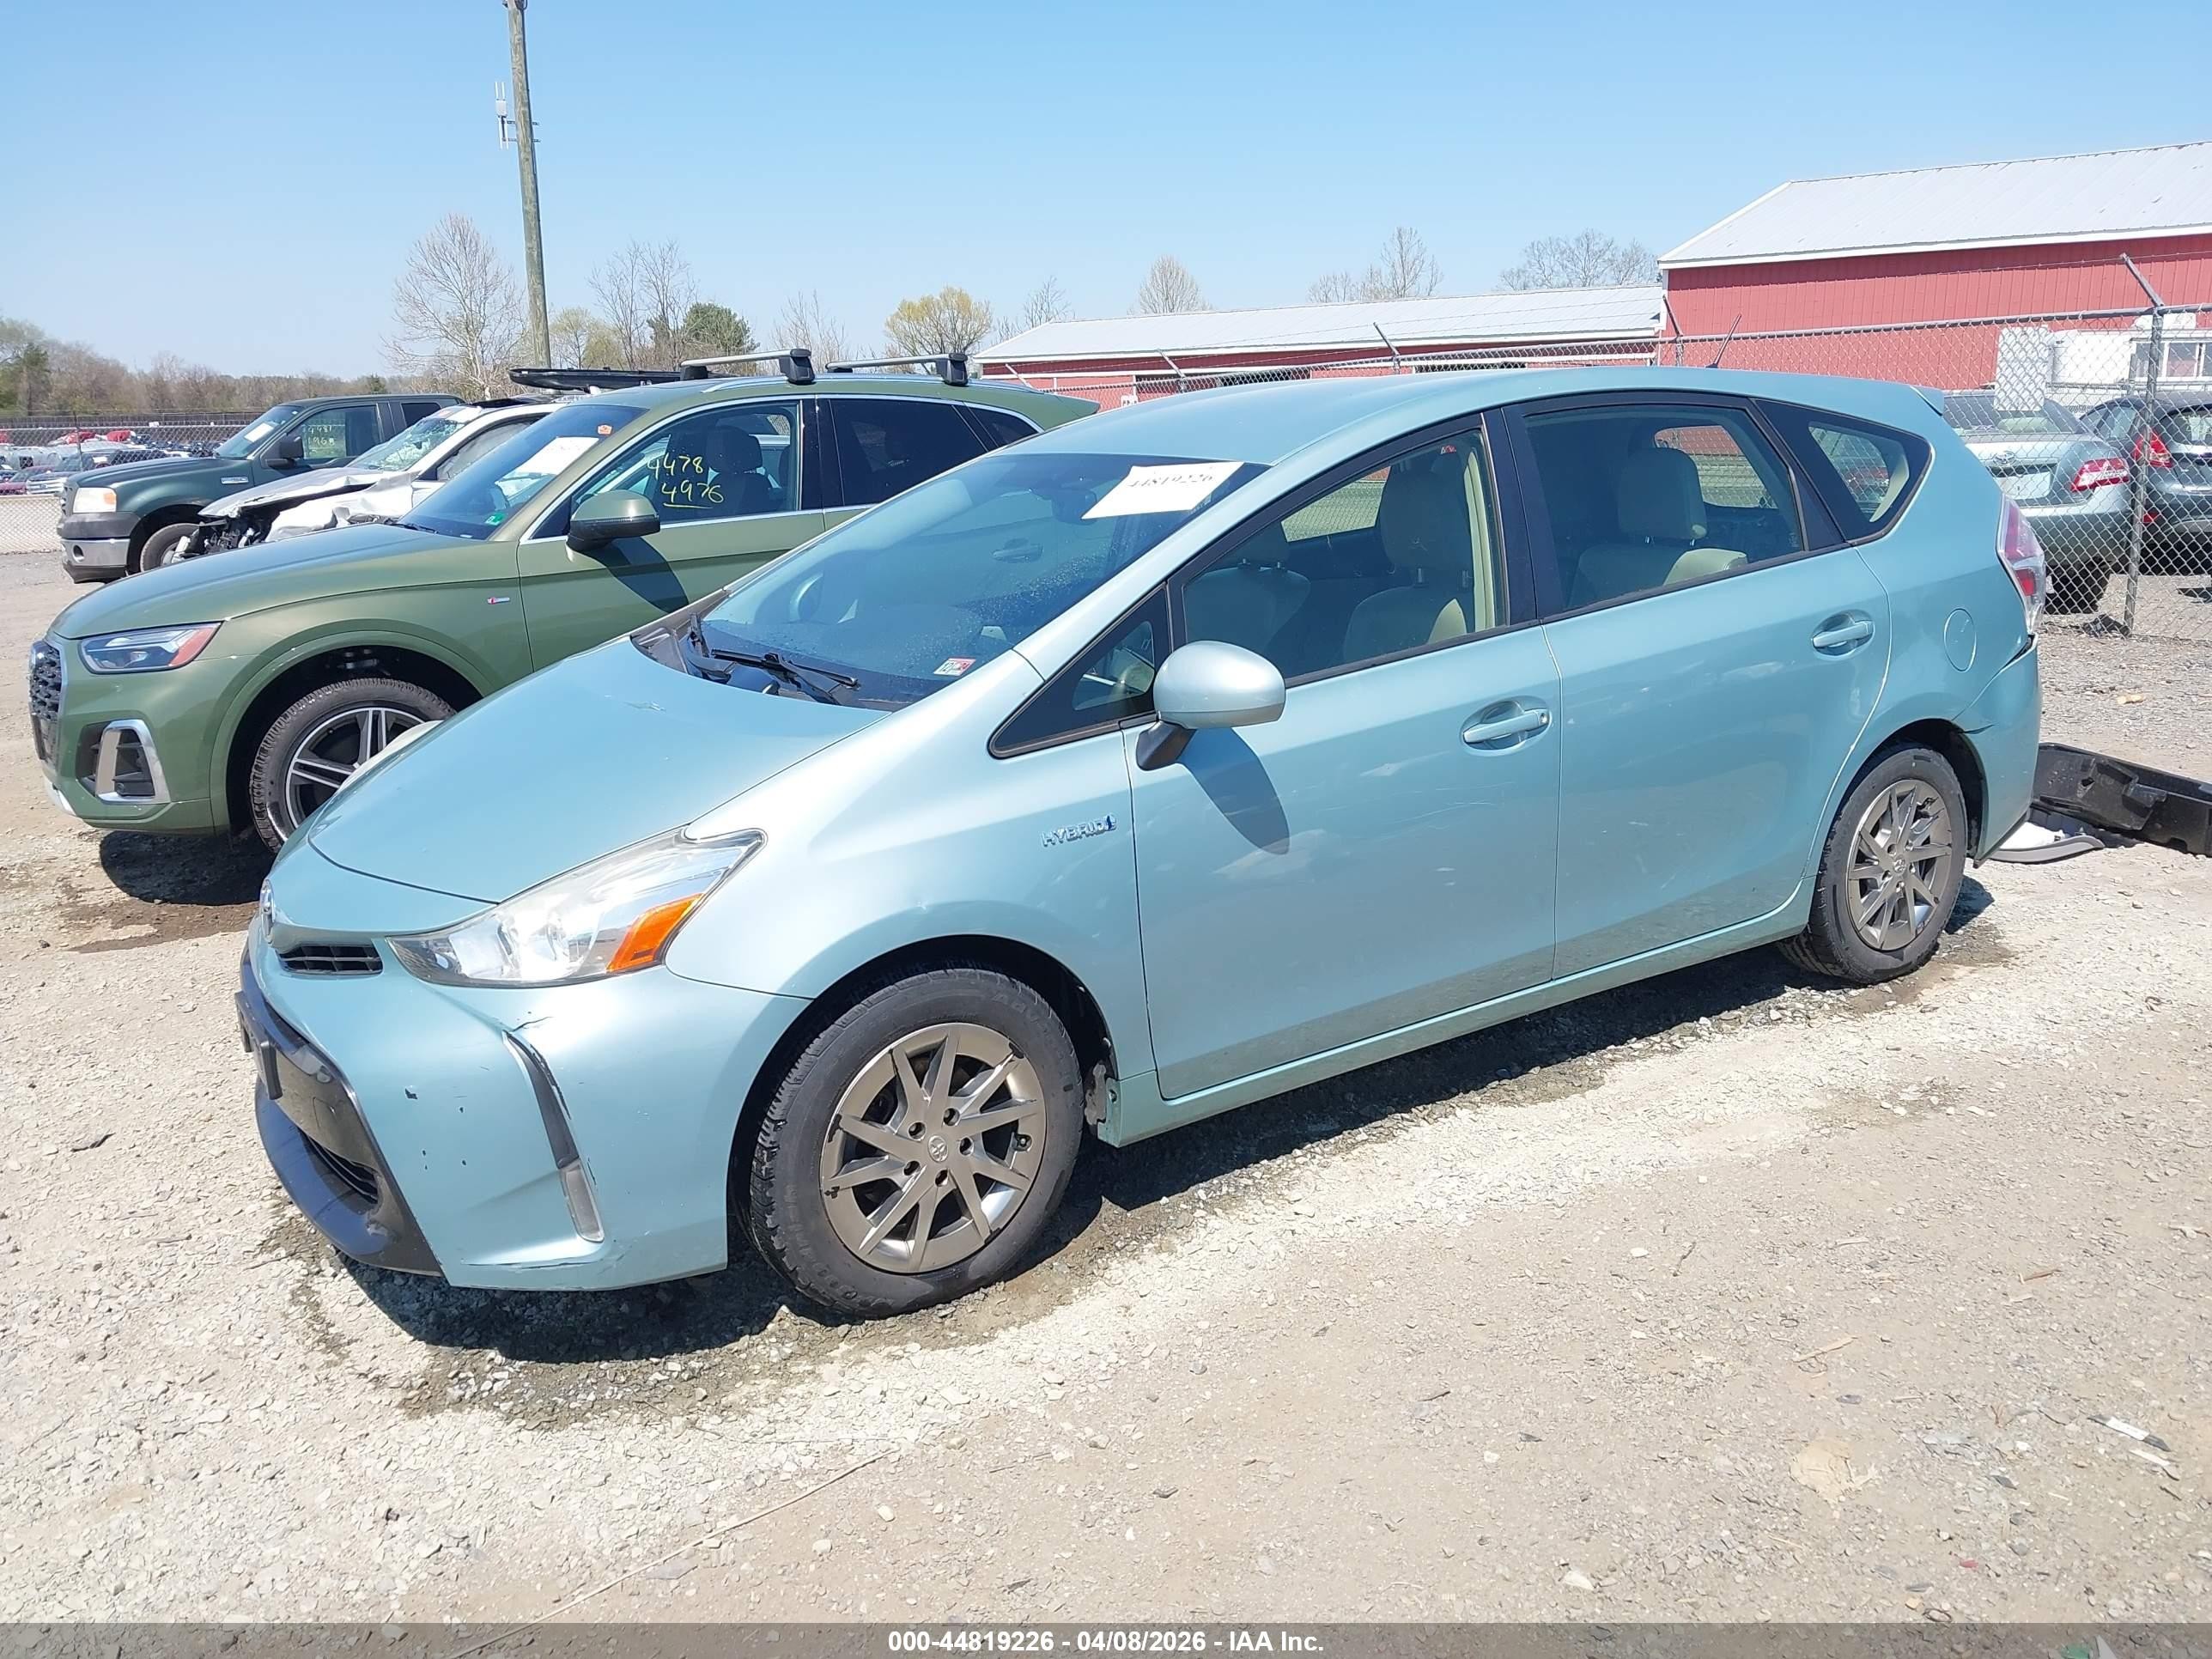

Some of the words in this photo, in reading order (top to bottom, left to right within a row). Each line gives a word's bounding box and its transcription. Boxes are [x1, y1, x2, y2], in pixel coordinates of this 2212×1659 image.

[647, 453, 704, 480] 4478
[661, 479, 724, 503] 4976
[1041, 818, 1106, 848] HYBRID
